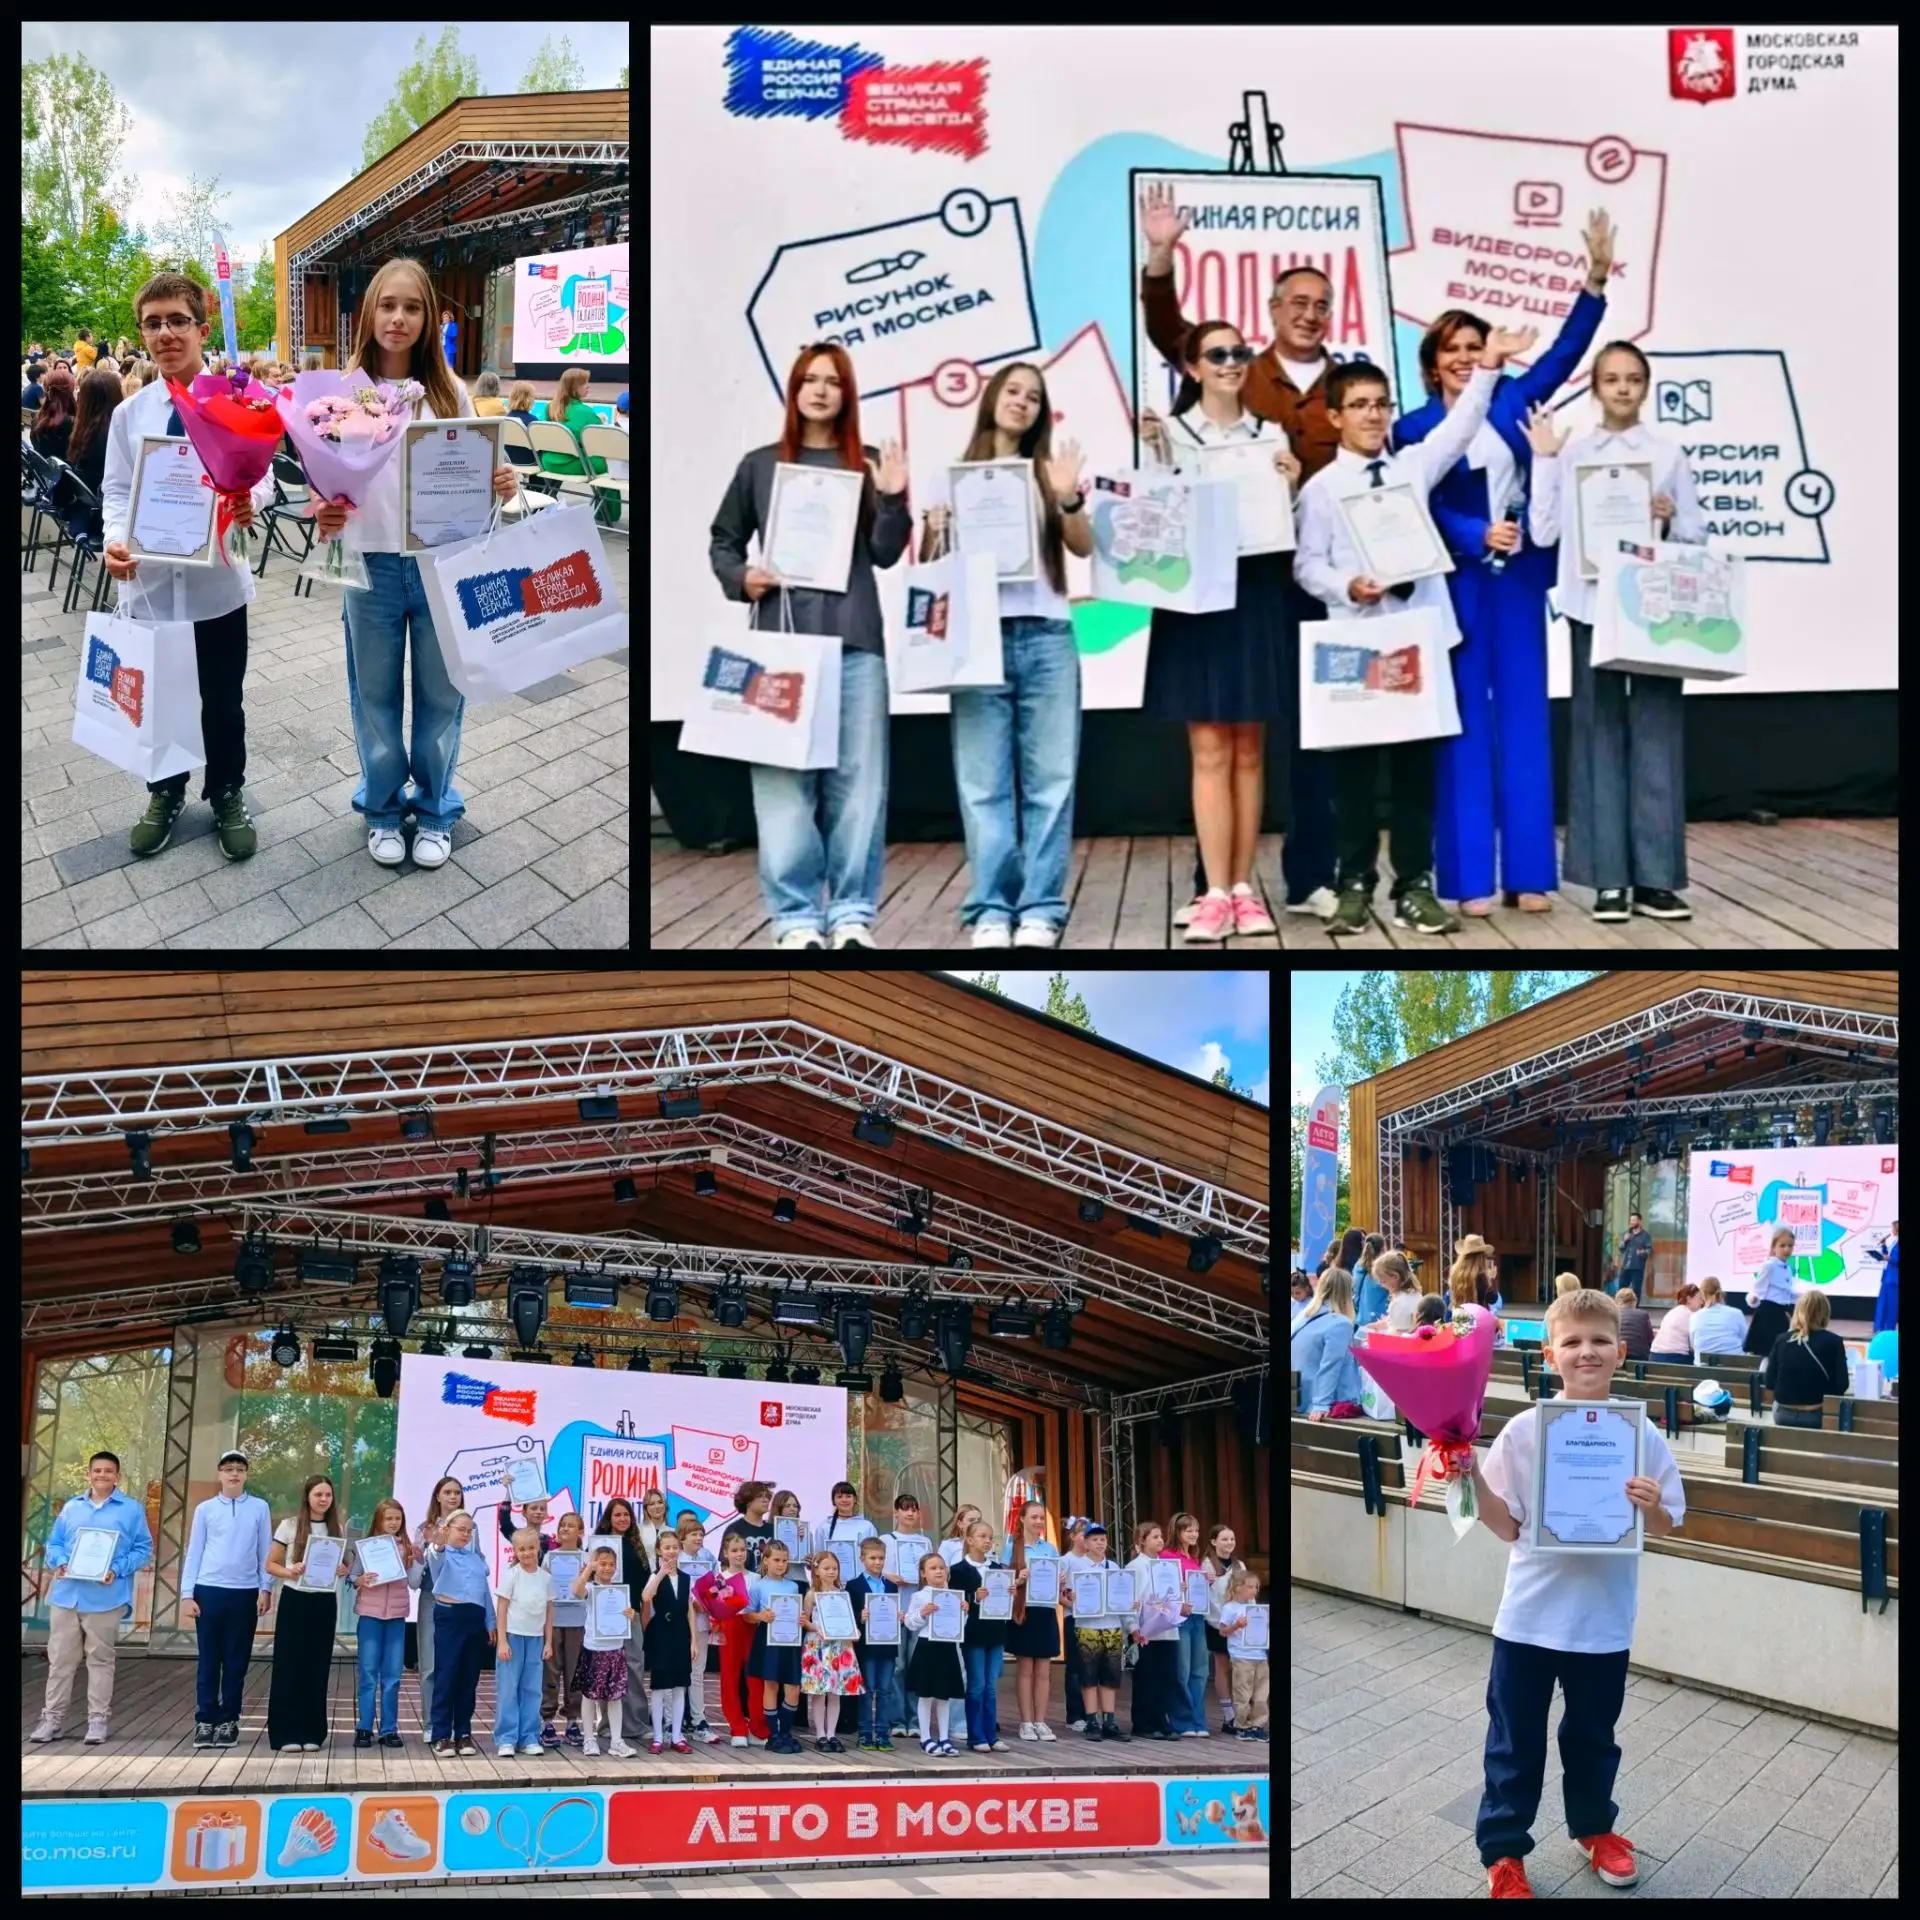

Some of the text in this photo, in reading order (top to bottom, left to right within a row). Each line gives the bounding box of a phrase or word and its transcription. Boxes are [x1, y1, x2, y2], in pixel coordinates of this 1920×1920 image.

[1746, 32, 1859, 48] МОСКОВСКАЯ
[762, 59, 841, 71] ЕДИНАЯ
[1747, 54, 1845, 70] ГОРОДСКАЯ
[762, 73, 842, 85] РОССИЯ
[866, 82, 962, 96] ВЕЛИКАЯ
[1747, 77, 1797, 93] ДУМА
[762, 87, 839, 100] СЕЙЧАС
[866, 98, 949, 110] СТРАНА
[866, 113, 974, 126] НАВСЕГДА
[1597, 148, 1626, 173] 2
[1177, 205, 1361, 232] ДИНАЯ РОССИЯ
[1431, 227, 1629, 278] ВИДЕОРОЛК
[814, 273, 955, 329] РИСУНОК
[1446, 282, 1573, 318] БУДУЩЕ
[871, 288, 996, 338] МОСКВА
[947, 373, 968, 392] 3
[1681, 444, 1781, 460] УРСИЯ
[1799, 483, 1822, 505] 4
[1706, 518, 1785, 536] АЙОН
[473, 575, 507, 597] ЕДИНАЯ
[531, 564, 574, 589] ВЕЛИКАЯ
[477, 585, 511, 608] РОССИЯ
[535, 578, 568, 599] СТРАНА
[539, 582, 588, 609] НАВСЕГДА
[480, 596, 513, 618] СЕЙЧАС
[785, 1412, 817, 1420] ГОРОДСКАЯ
[590, 1446, 659, 1461] ЕДИНАЯ РОССИЯ
[469, 1468, 505, 1482] РИСУН
[592, 1459, 659, 1499] РОДИНА
[681, 1461, 745, 1483] ВИДЕОРОЛИК
[691, 1473, 731, 1489] МОСКВА
[687, 1797, 1099, 1845] ЛЕТО В МОСКВЕ
